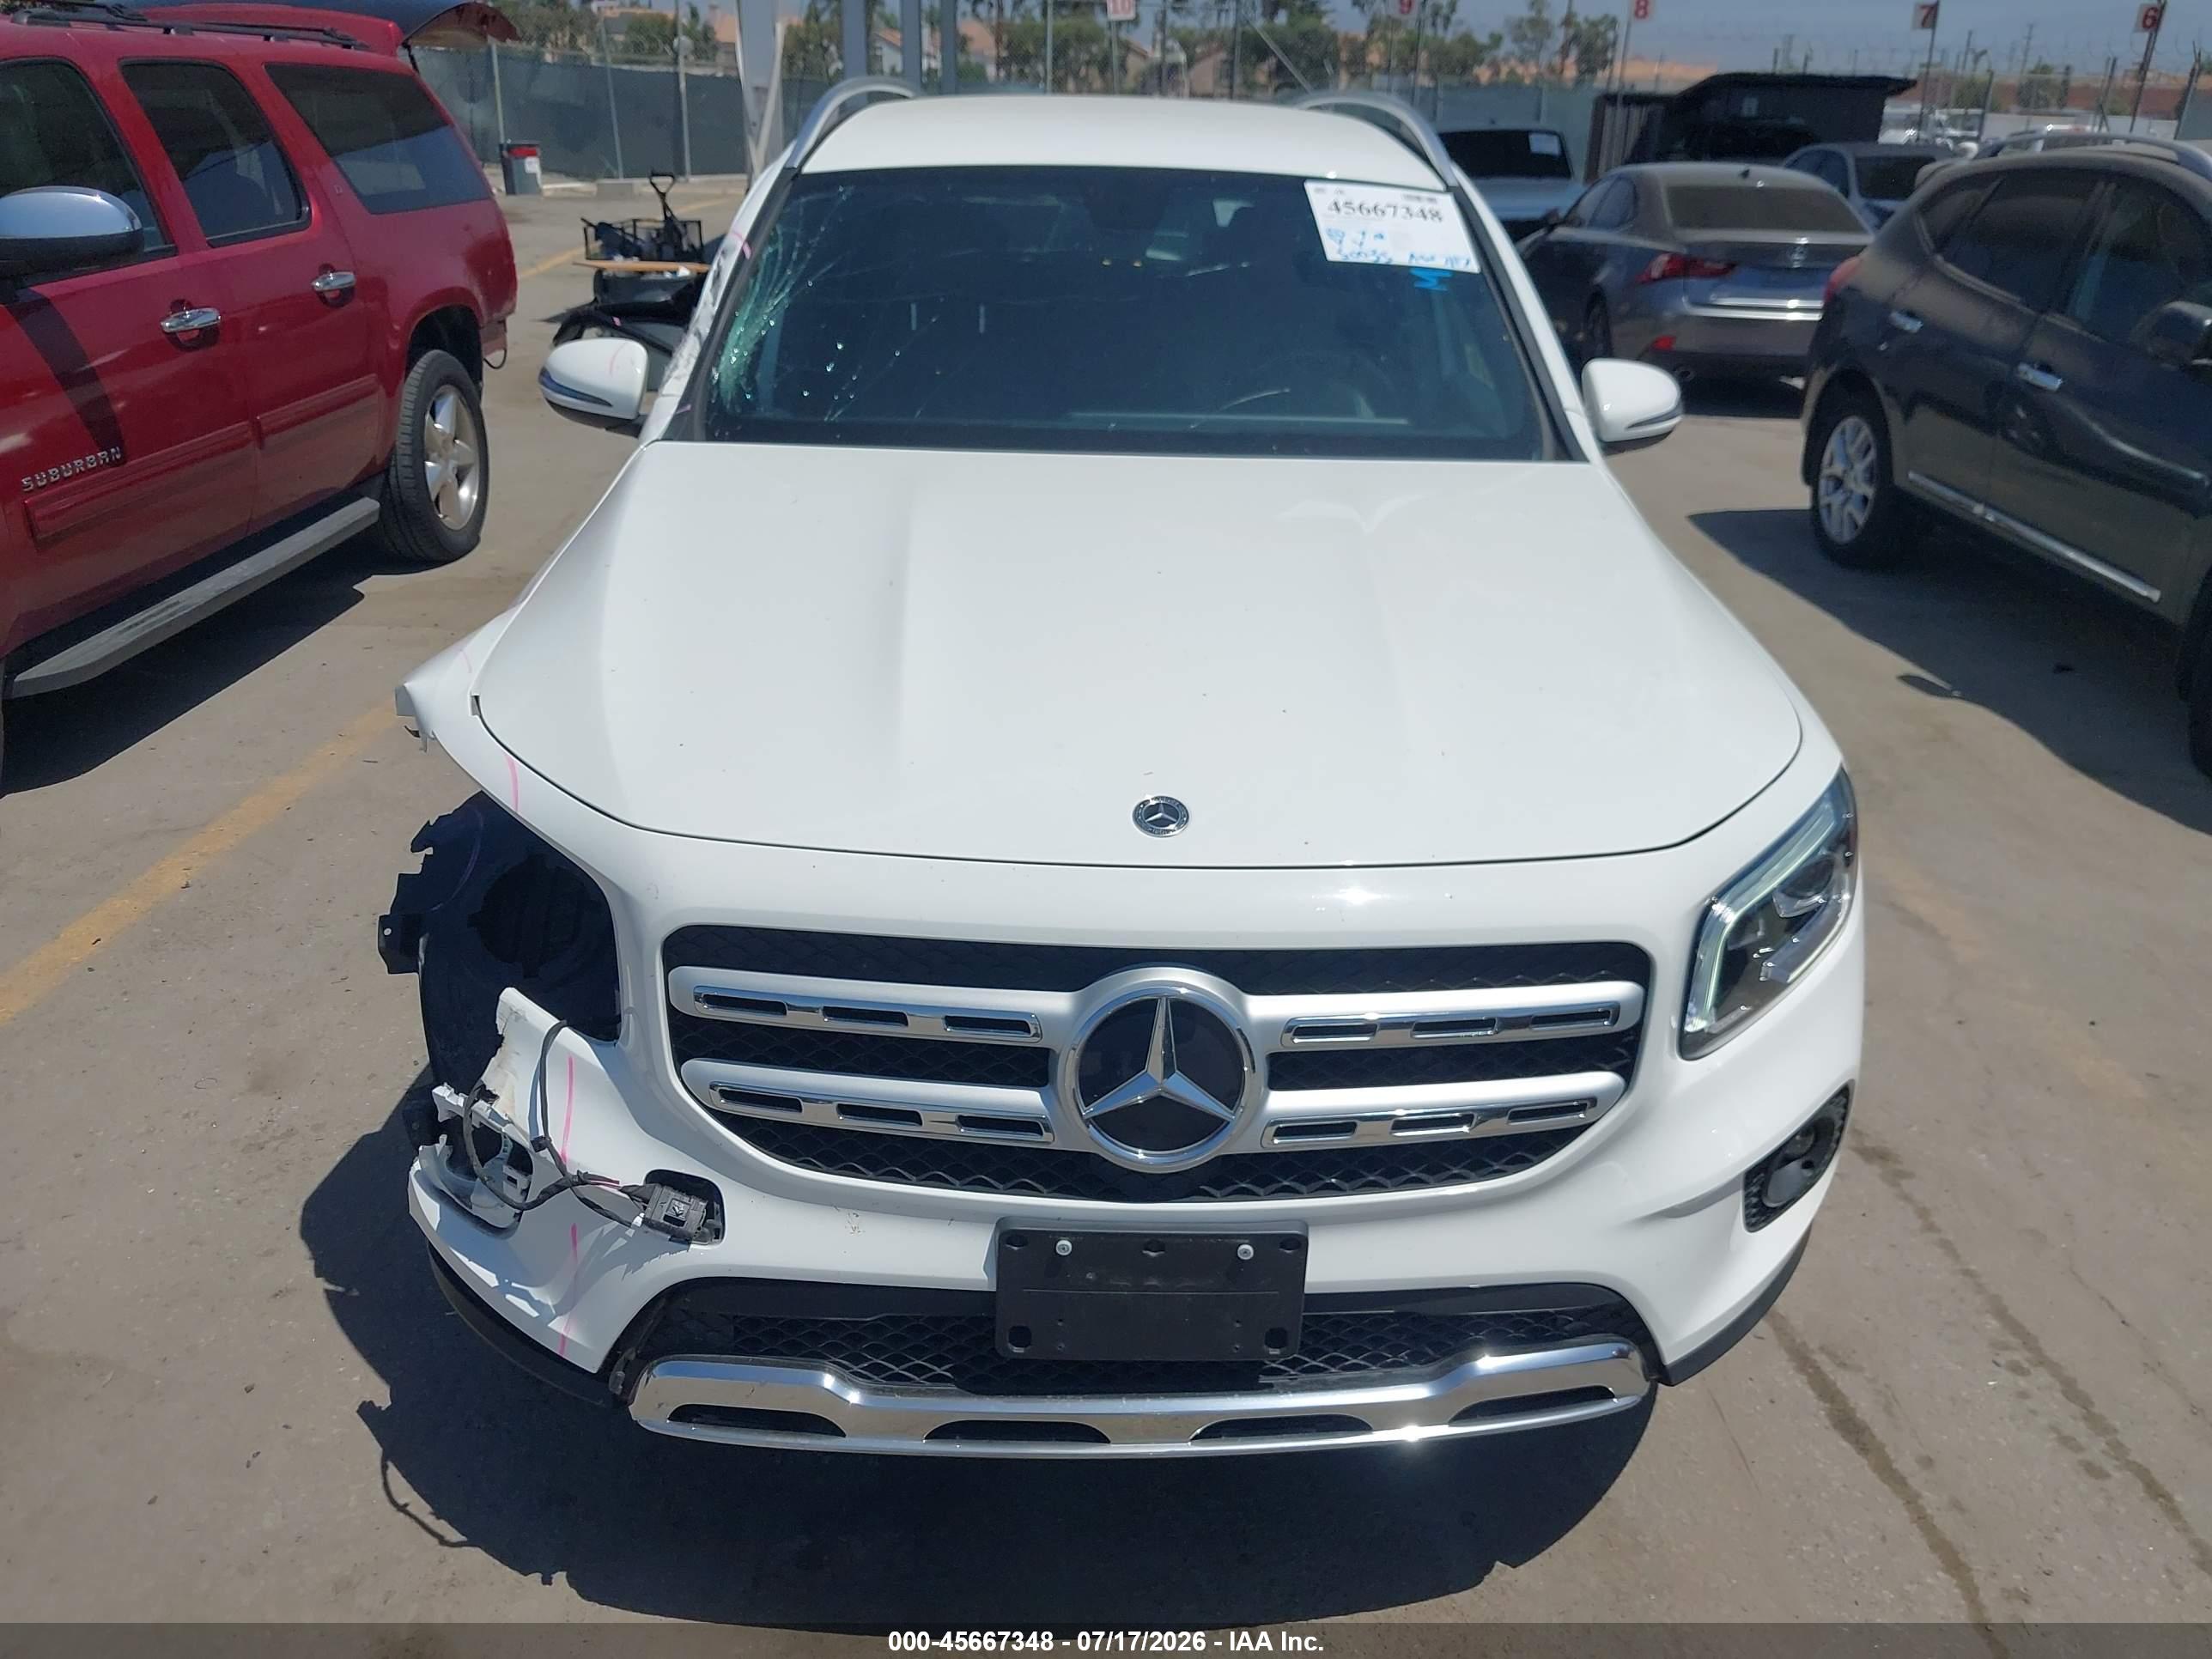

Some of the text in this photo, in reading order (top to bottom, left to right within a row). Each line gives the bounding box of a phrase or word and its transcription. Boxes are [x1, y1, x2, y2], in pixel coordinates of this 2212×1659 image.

[1634, 0, 1649, 19] 8
[1919, 4, 1935, 27] 7
[2142, 7, 2158, 29] 6
[1328, 199, 1443, 223] 45667348
[21, 447, 122, 492] SUBURBAN
